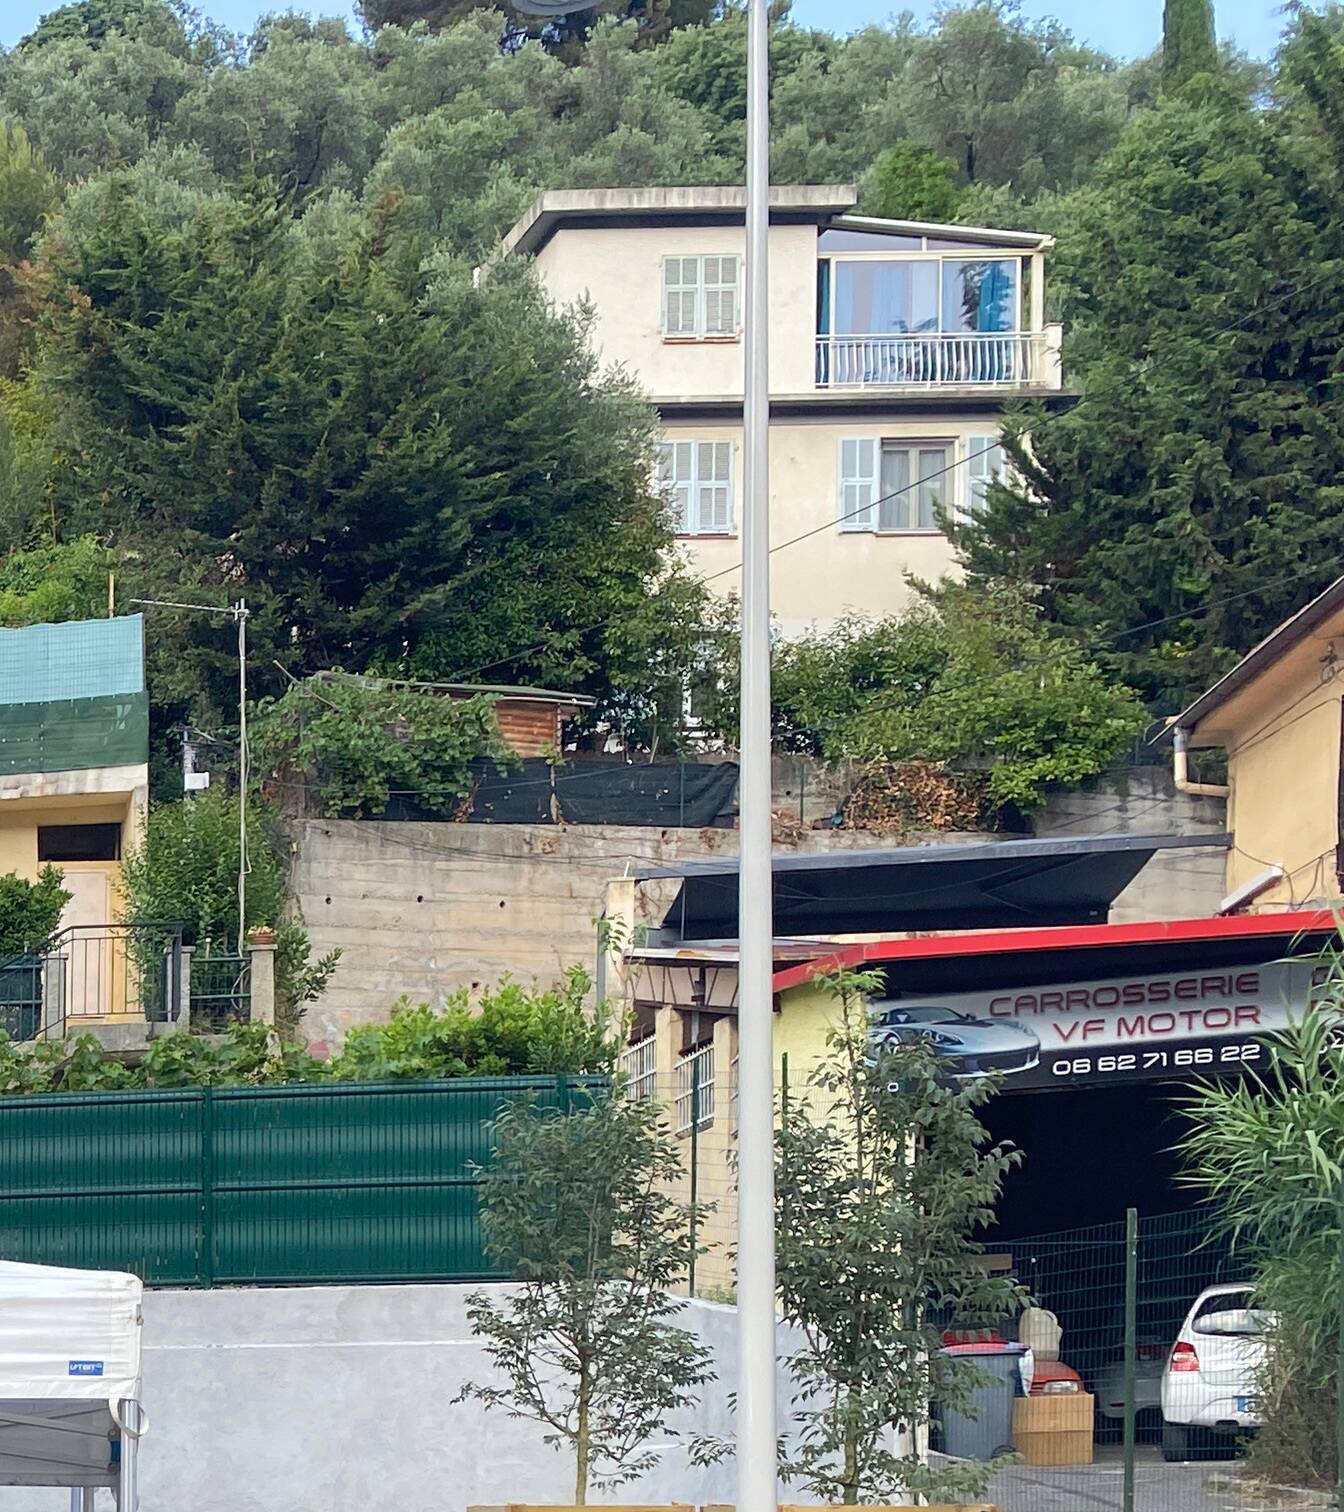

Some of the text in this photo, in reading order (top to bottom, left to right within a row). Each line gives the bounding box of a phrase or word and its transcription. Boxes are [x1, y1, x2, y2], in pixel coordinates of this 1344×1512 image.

[989, 972, 1260, 1018] CARROSSERIE
[1052, 1005, 1262, 1043] VF MOTOR
[1052, 1044, 1261, 1076] 06 62 71 66 22
